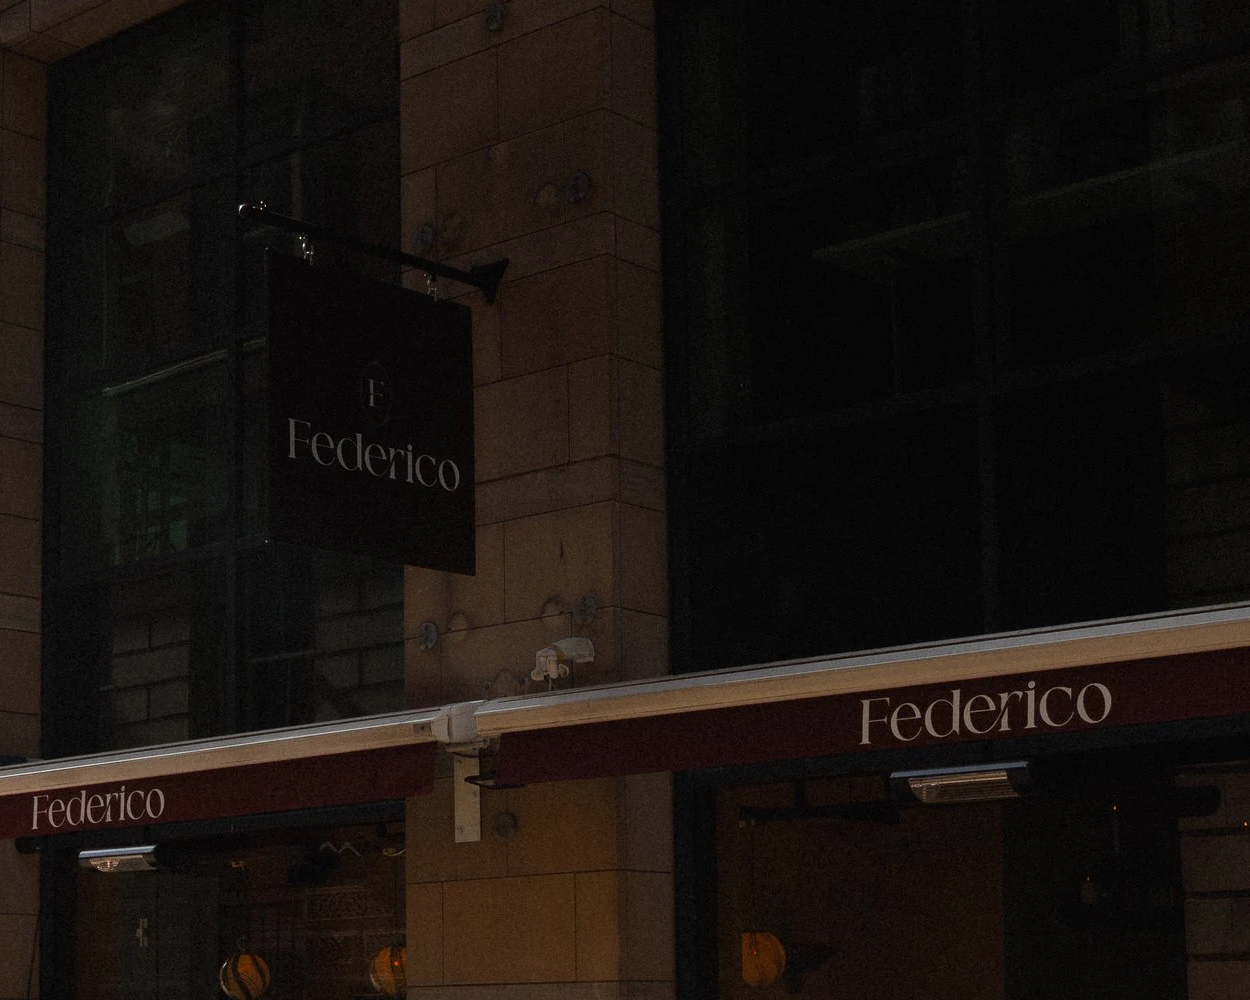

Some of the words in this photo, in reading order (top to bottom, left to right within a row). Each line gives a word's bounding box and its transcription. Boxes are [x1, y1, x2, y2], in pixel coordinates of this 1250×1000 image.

[367, 378, 385, 408] F
[287, 417, 460, 492] Federico
[859, 680, 1112, 745] Federico
[31, 785, 165, 830] Federico
